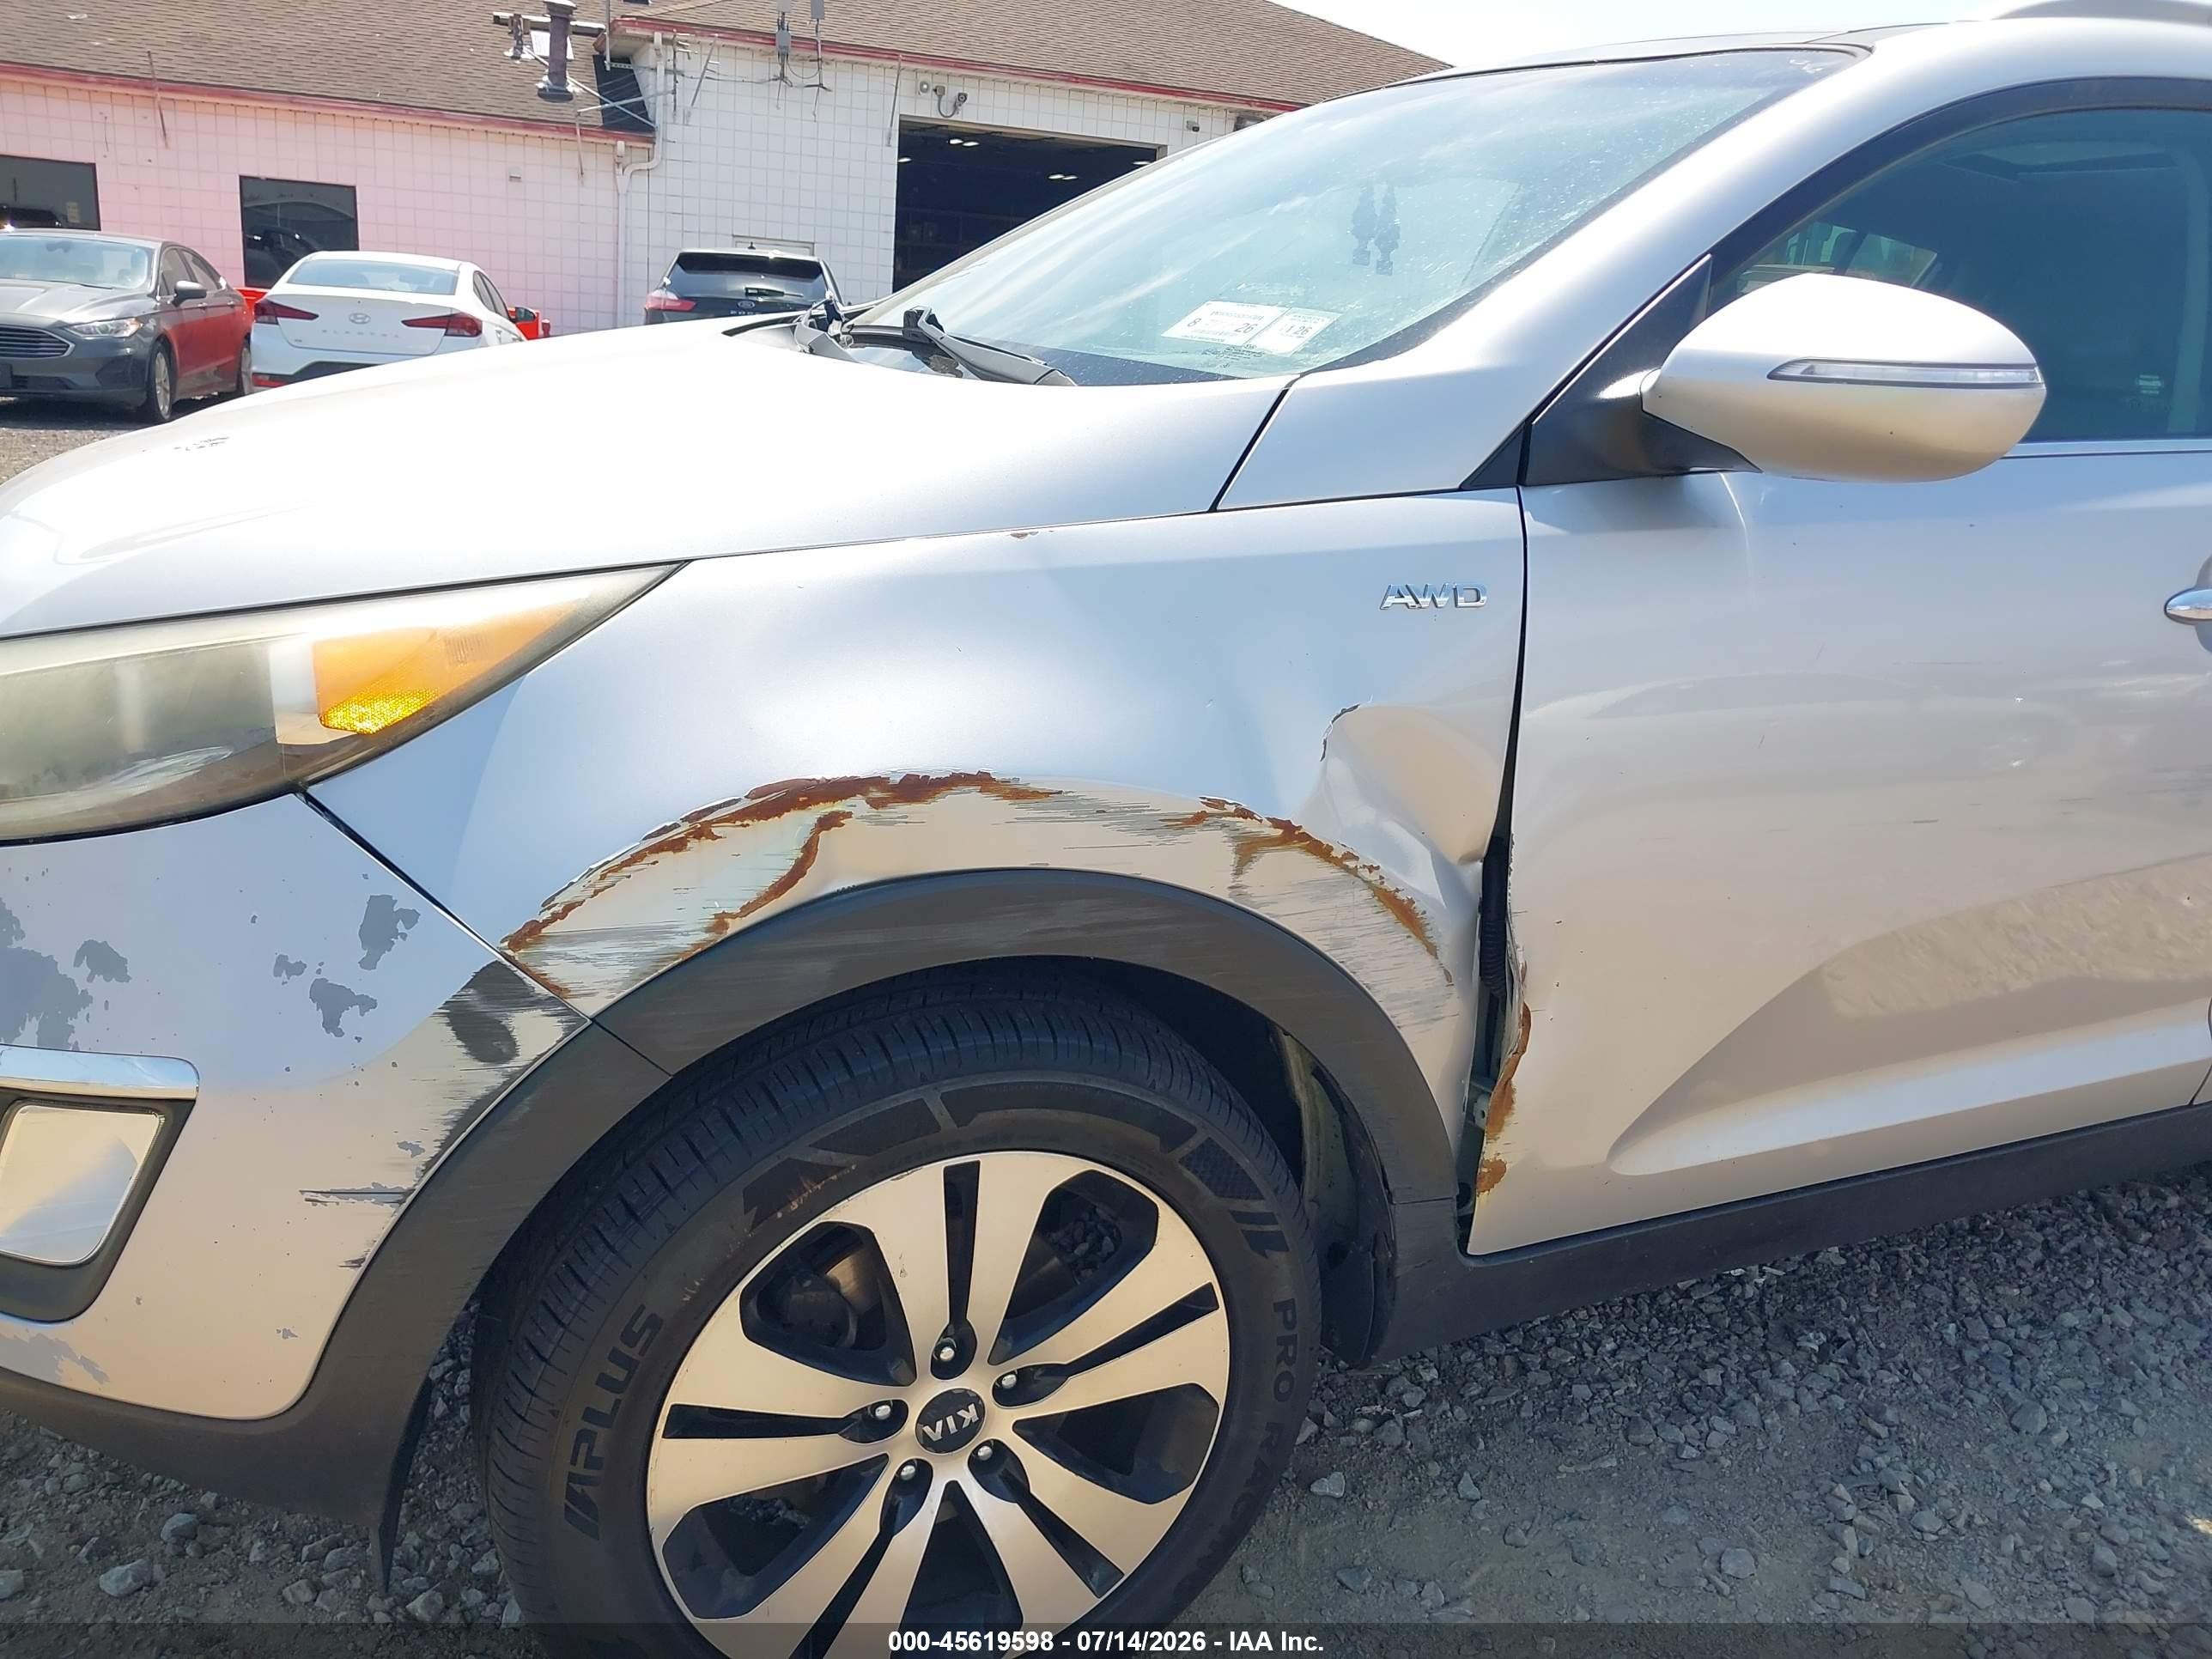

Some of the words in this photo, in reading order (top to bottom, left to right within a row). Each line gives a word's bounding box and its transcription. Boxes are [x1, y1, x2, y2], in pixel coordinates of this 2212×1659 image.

[1233, 322, 1259, 334] 26
[1379, 582, 1487, 610] AWD
[1273, 1297, 1300, 1403] PRO
[922, 1402, 980, 1442] KIA
